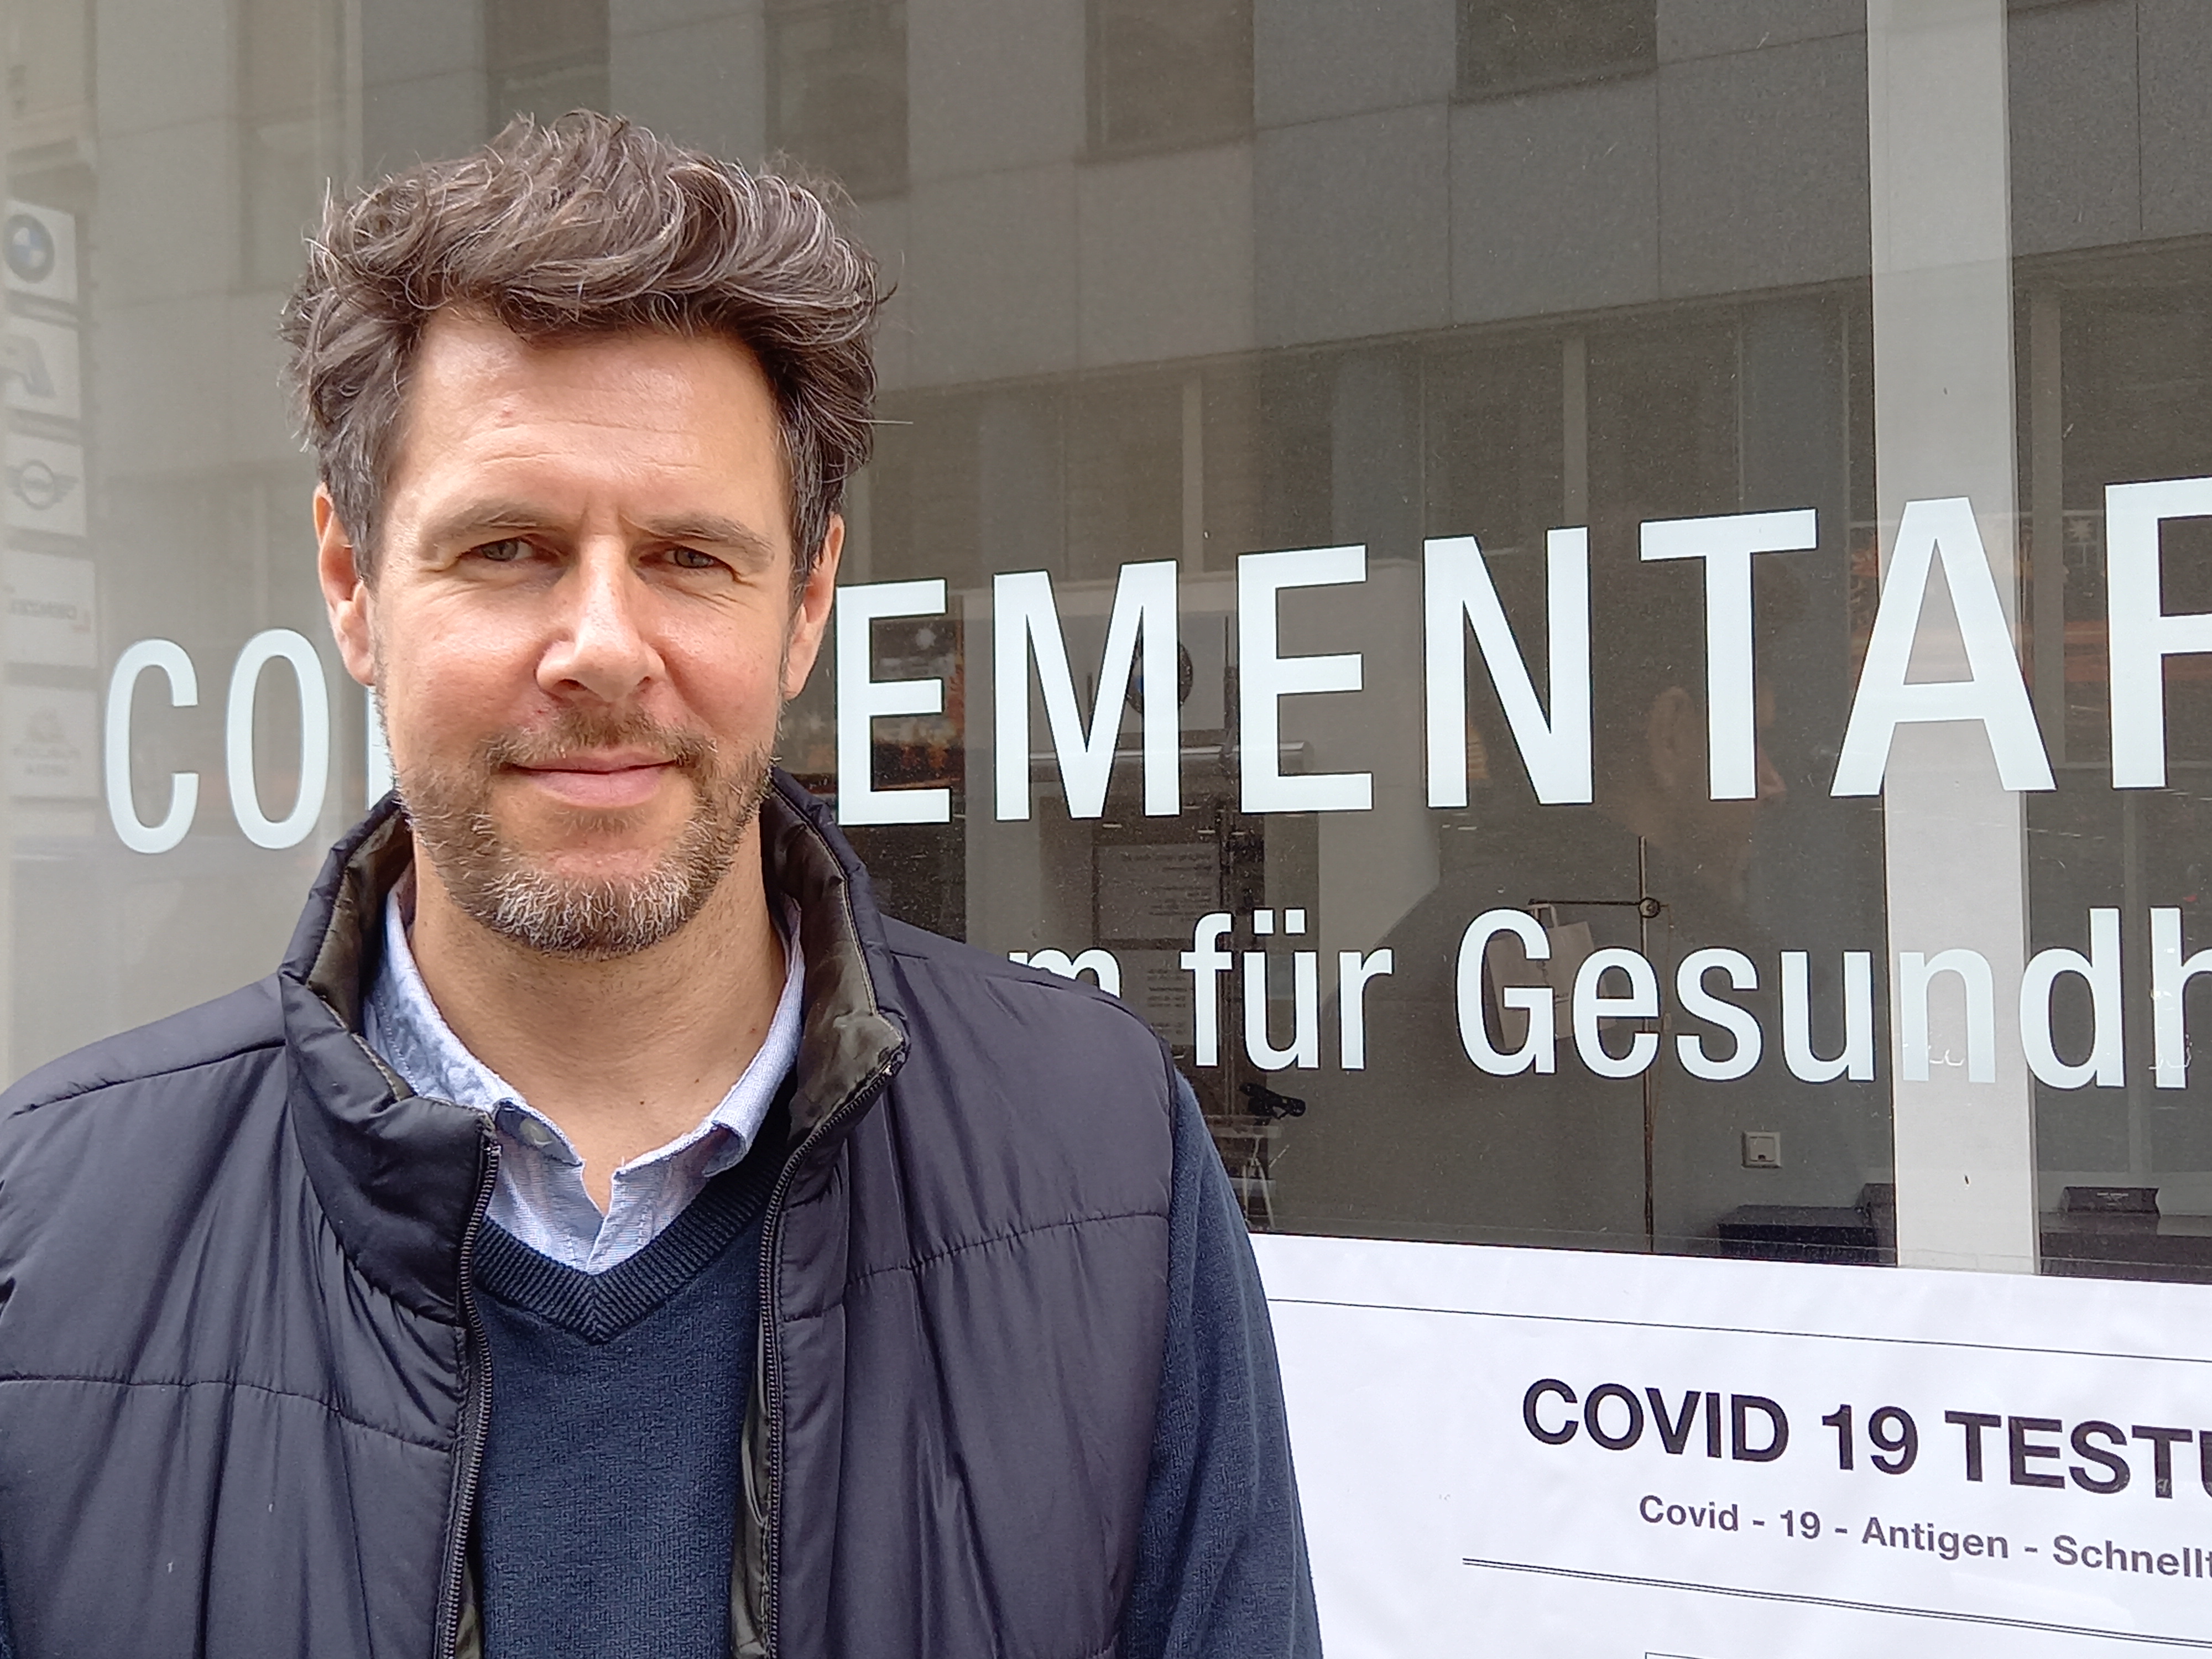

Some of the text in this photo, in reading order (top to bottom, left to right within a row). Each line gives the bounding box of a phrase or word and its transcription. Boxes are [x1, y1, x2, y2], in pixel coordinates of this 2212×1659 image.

[105, 476, 2212, 853] COEMENTA
[1180, 908, 1393, 1071] für
[1522, 1378, 2212, 1499] COVID 19 TEST
[1640, 1495, 1739, 1532] Covid
[1780, 1510, 1820, 1540] 19
[1861, 1516, 2008, 1561] Antigen
